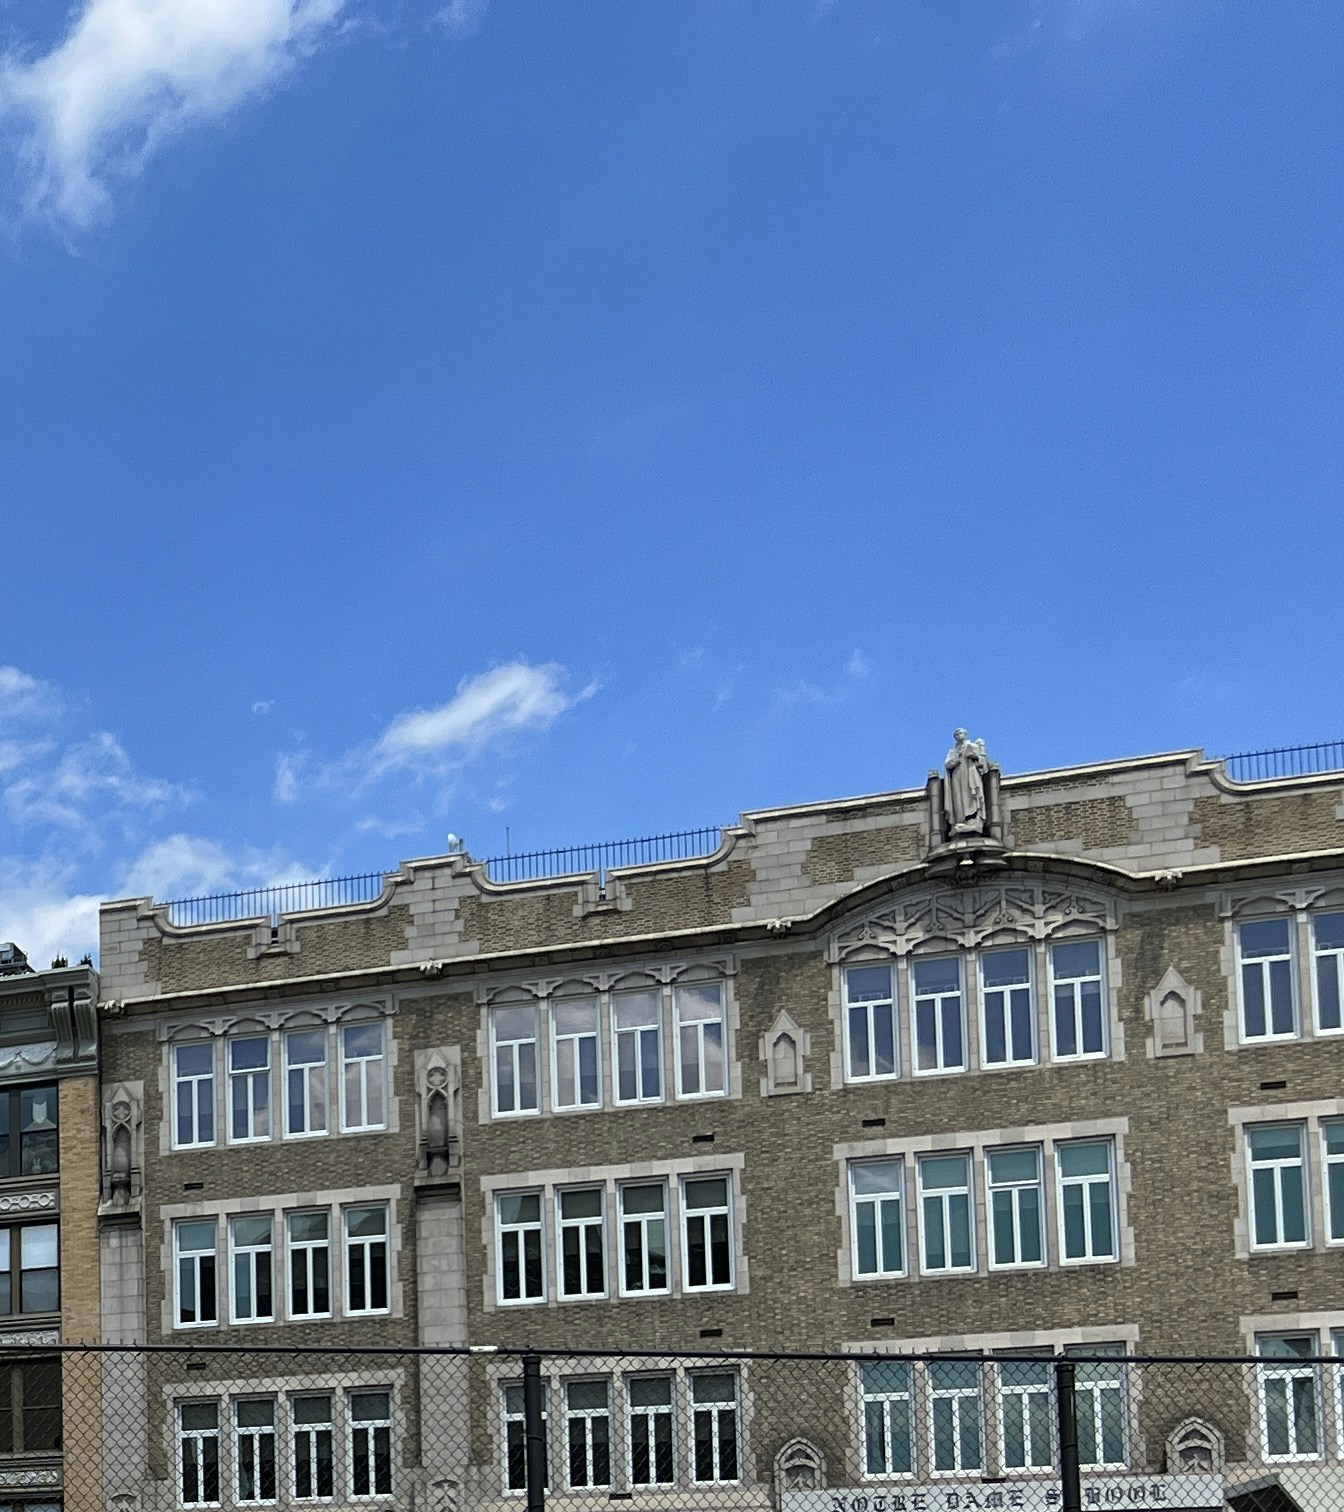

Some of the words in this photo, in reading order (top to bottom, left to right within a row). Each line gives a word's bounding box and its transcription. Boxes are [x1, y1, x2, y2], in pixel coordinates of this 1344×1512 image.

[831, 1494, 928, 1512] NOTRE
[945, 1490, 1024, 1509] DAME
[1045, 1484, 1166, 1505] SHOOL
